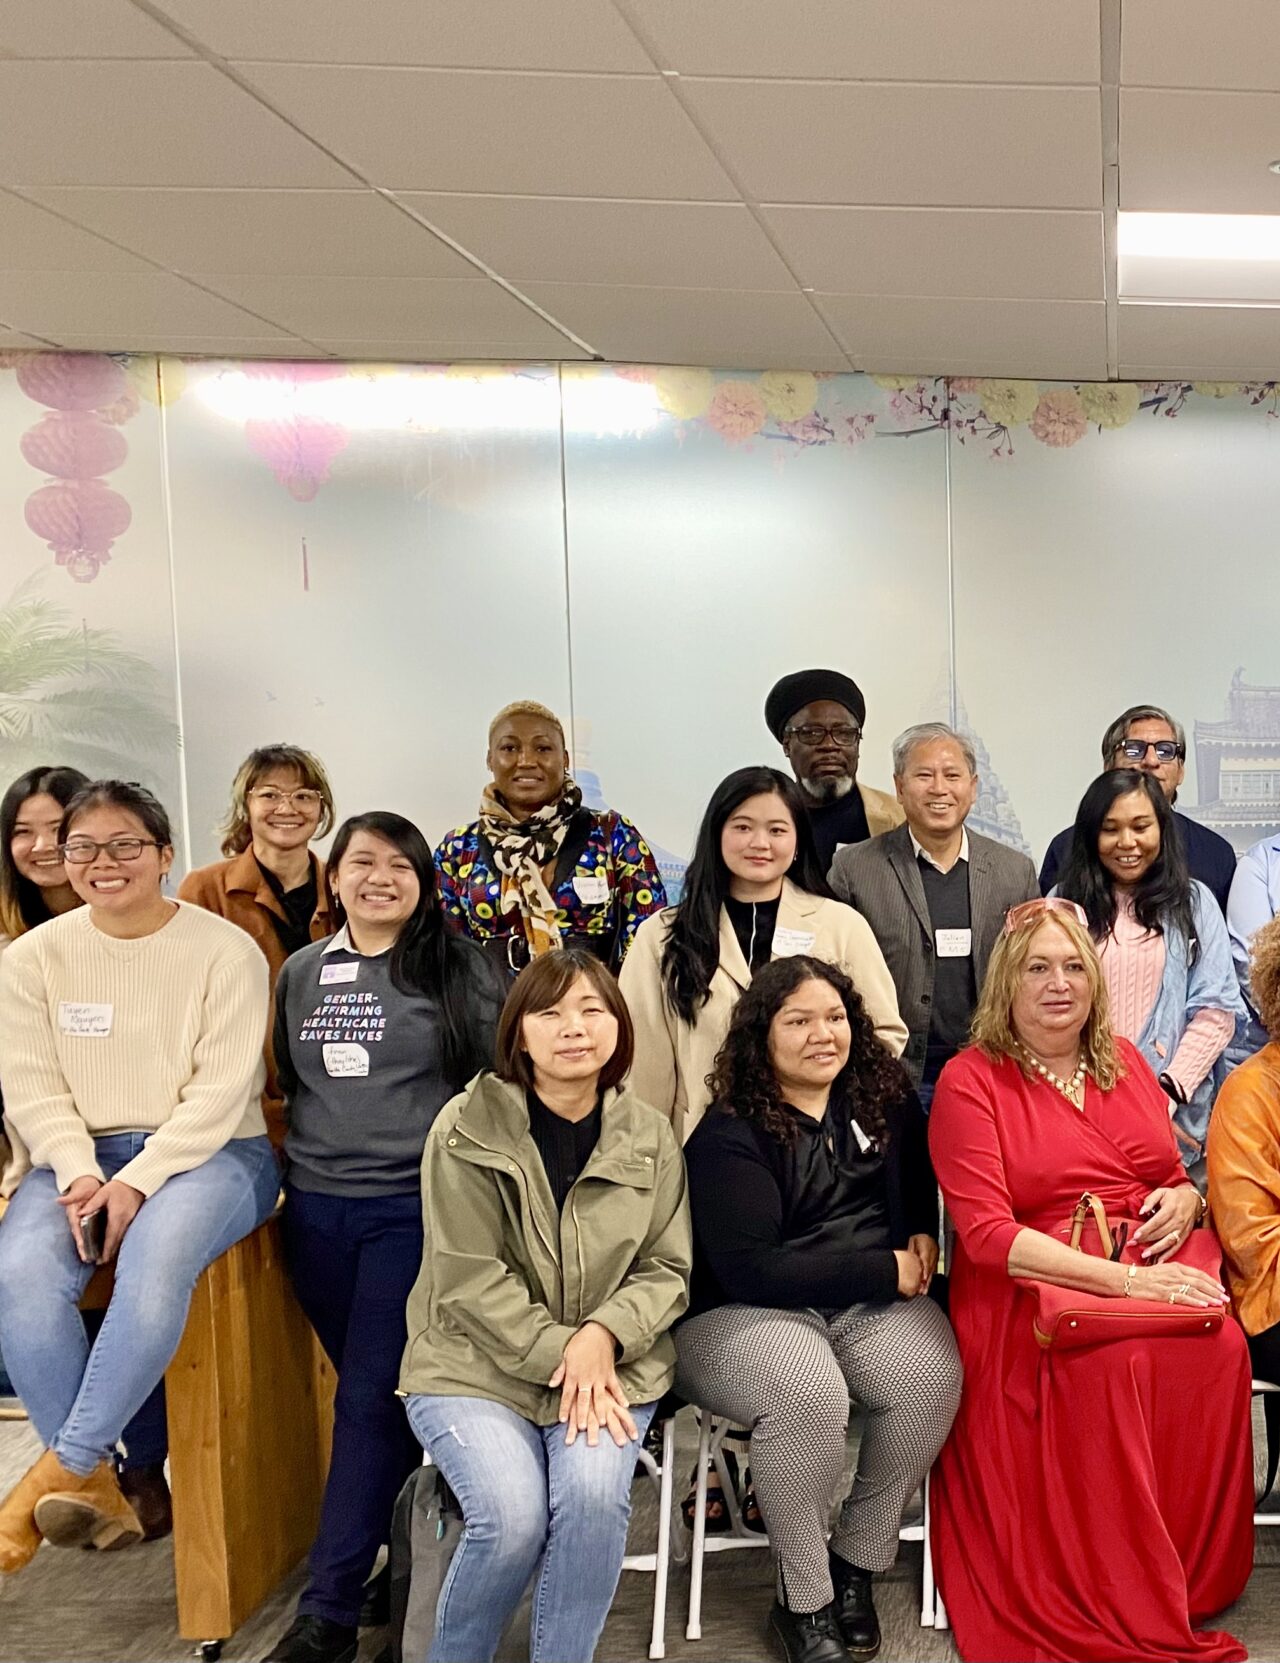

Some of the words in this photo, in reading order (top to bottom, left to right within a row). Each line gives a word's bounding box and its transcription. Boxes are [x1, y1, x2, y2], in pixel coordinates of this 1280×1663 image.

[323, 993, 379, 1004] GENDER-
[312, 1005, 383, 1016] AFFIRMING
[302, 1017, 386, 1028] HEALTHCARE
[299, 1030, 341, 1041] SAVES
[344, 1030, 384, 1041] LIVES
